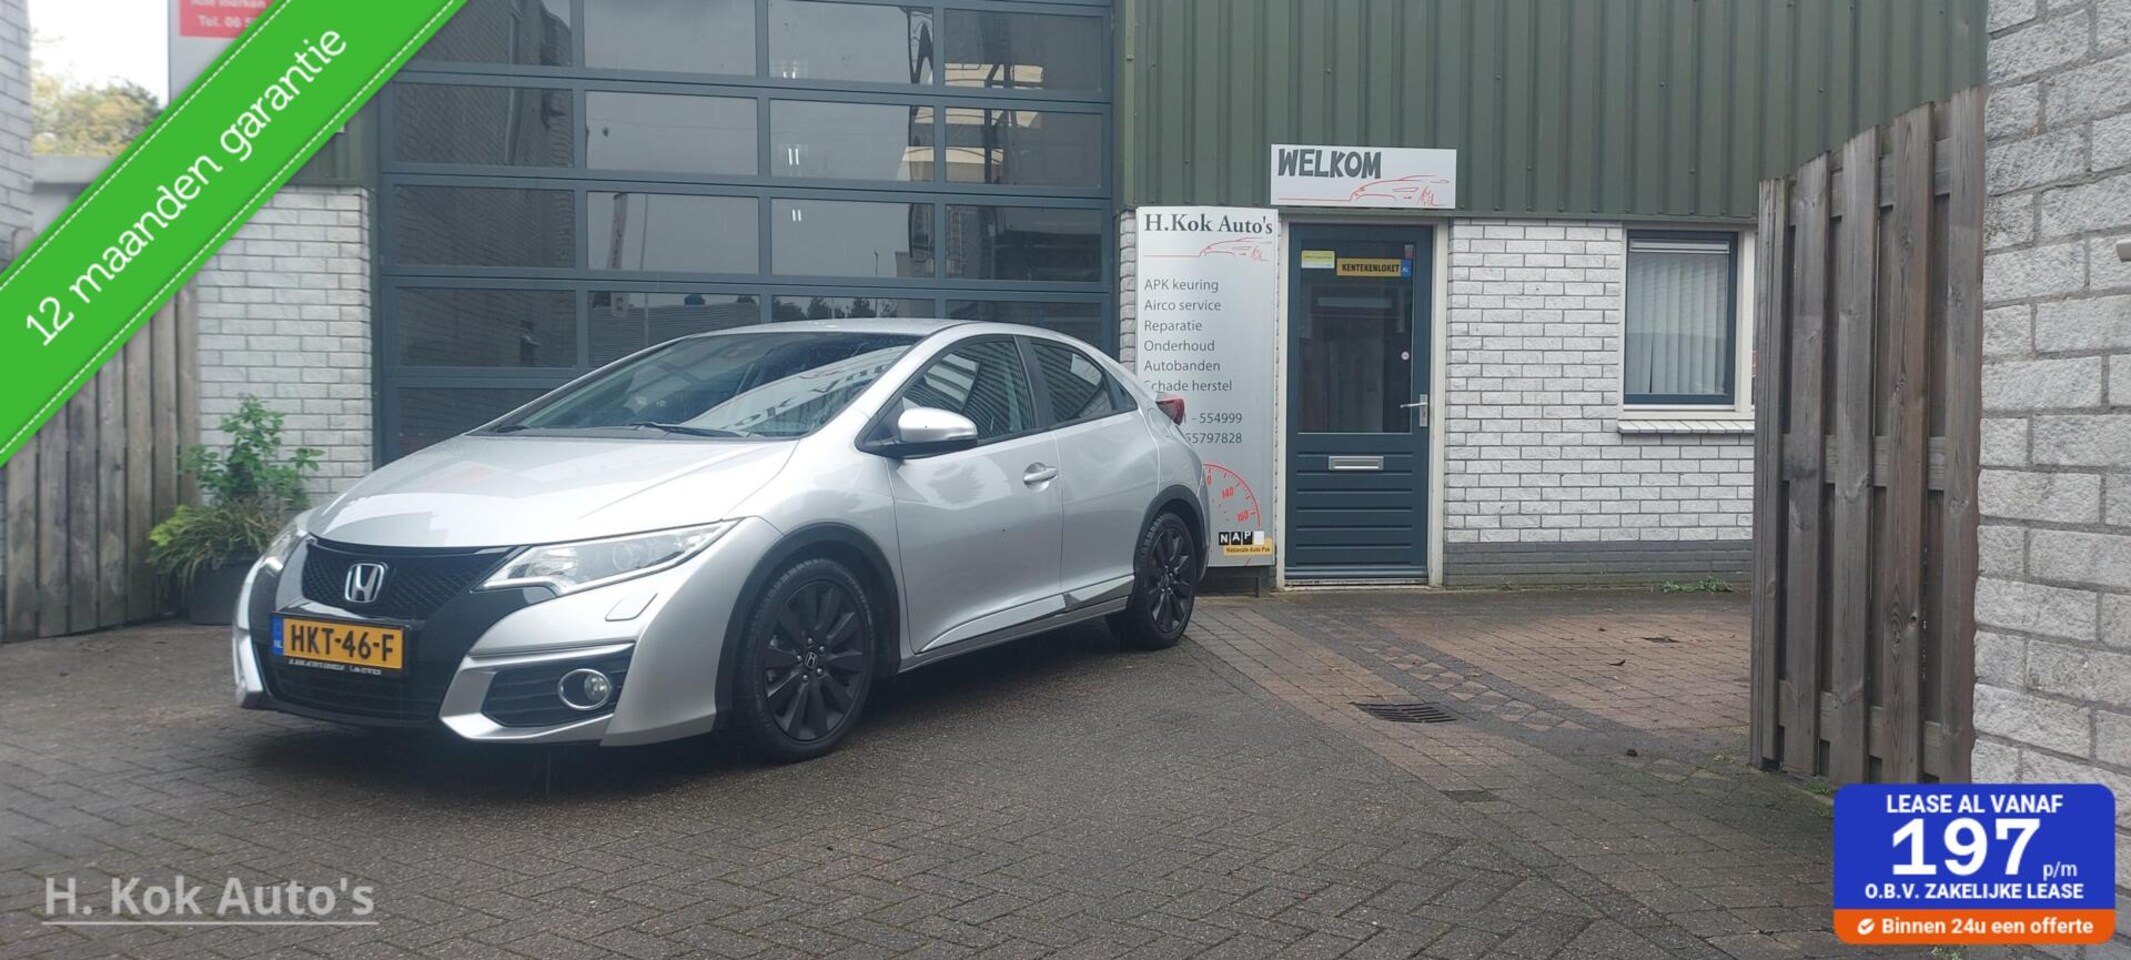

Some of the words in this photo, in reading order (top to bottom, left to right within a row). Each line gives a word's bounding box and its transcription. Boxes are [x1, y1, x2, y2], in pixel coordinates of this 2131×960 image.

[1278, 148, 1382, 179] WELKOM
[1144, 213, 1212, 232] H.Kok
[1218, 215, 1273, 234] Auto's
[1342, 263, 1399, 272] KENTEKENLOKET
[1144, 279, 1169, 290] APK
[1173, 279, 1219, 293] keuring
[1144, 299, 1176, 311] Airco
[1179, 301, 1221, 311] service
[1144, 320, 1202, 333] Reparatie
[1144, 340, 1215, 351] Onderhoud
[1144, 360, 1221, 371] Autobanden
[1192, 379, 1232, 391] herstel
[1199, 412, 1243, 424] 554999
[290, 624, 395, 662] HKT-46-F
